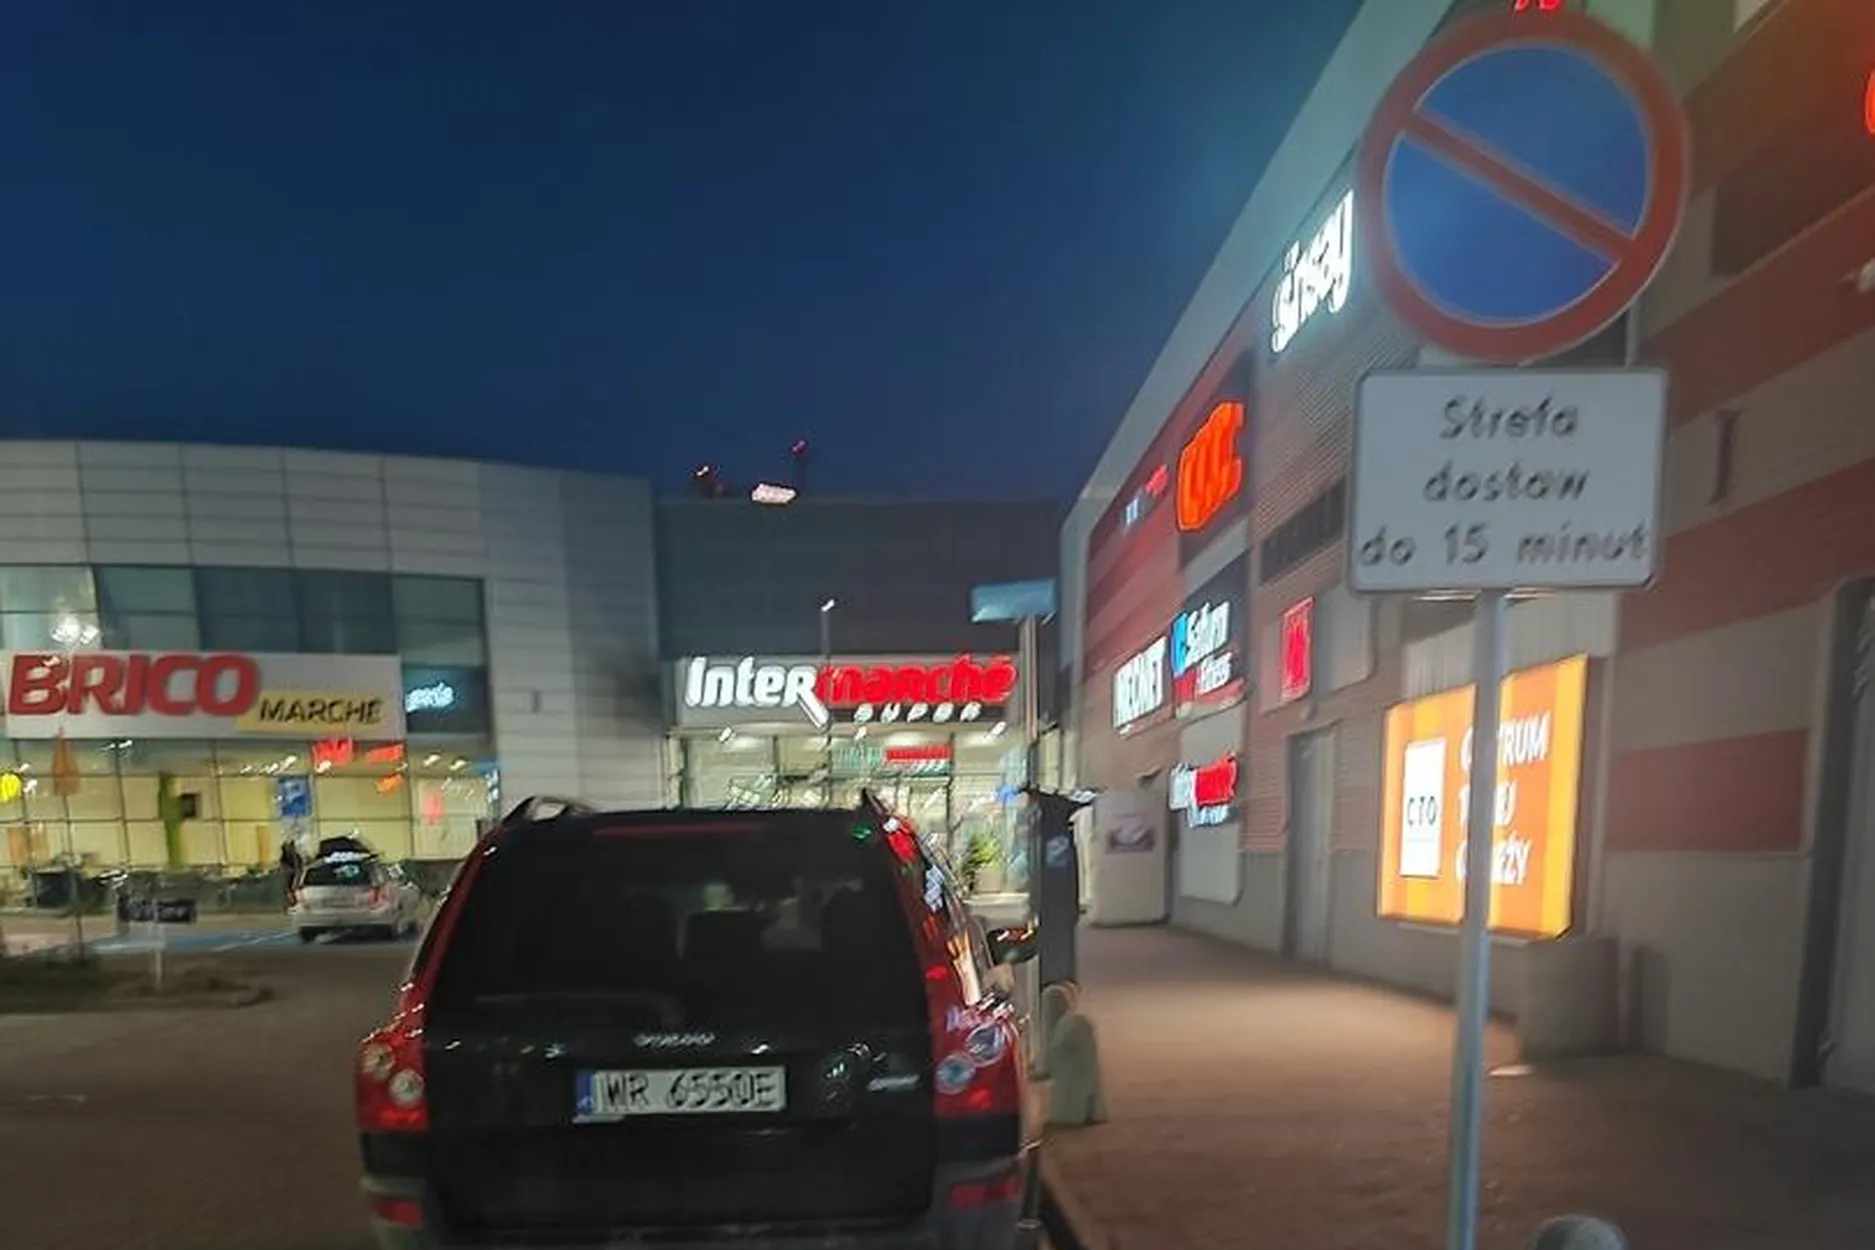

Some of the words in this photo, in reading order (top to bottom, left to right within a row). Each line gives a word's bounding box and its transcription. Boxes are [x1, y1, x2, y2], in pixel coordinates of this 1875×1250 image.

[1440, 396, 1577, 438] Strefa
[1424, 460, 1590, 501] dostaw
[1360, 524, 1417, 566] do
[1444, 522, 1488, 566] 15
[1516, 520, 1651, 564] minut
[8, 653, 261, 717] BRICO
[259, 698, 382, 726] MARCHE
[1407, 795, 1437, 826] CTO
[605, 1071, 650, 1107] WR
